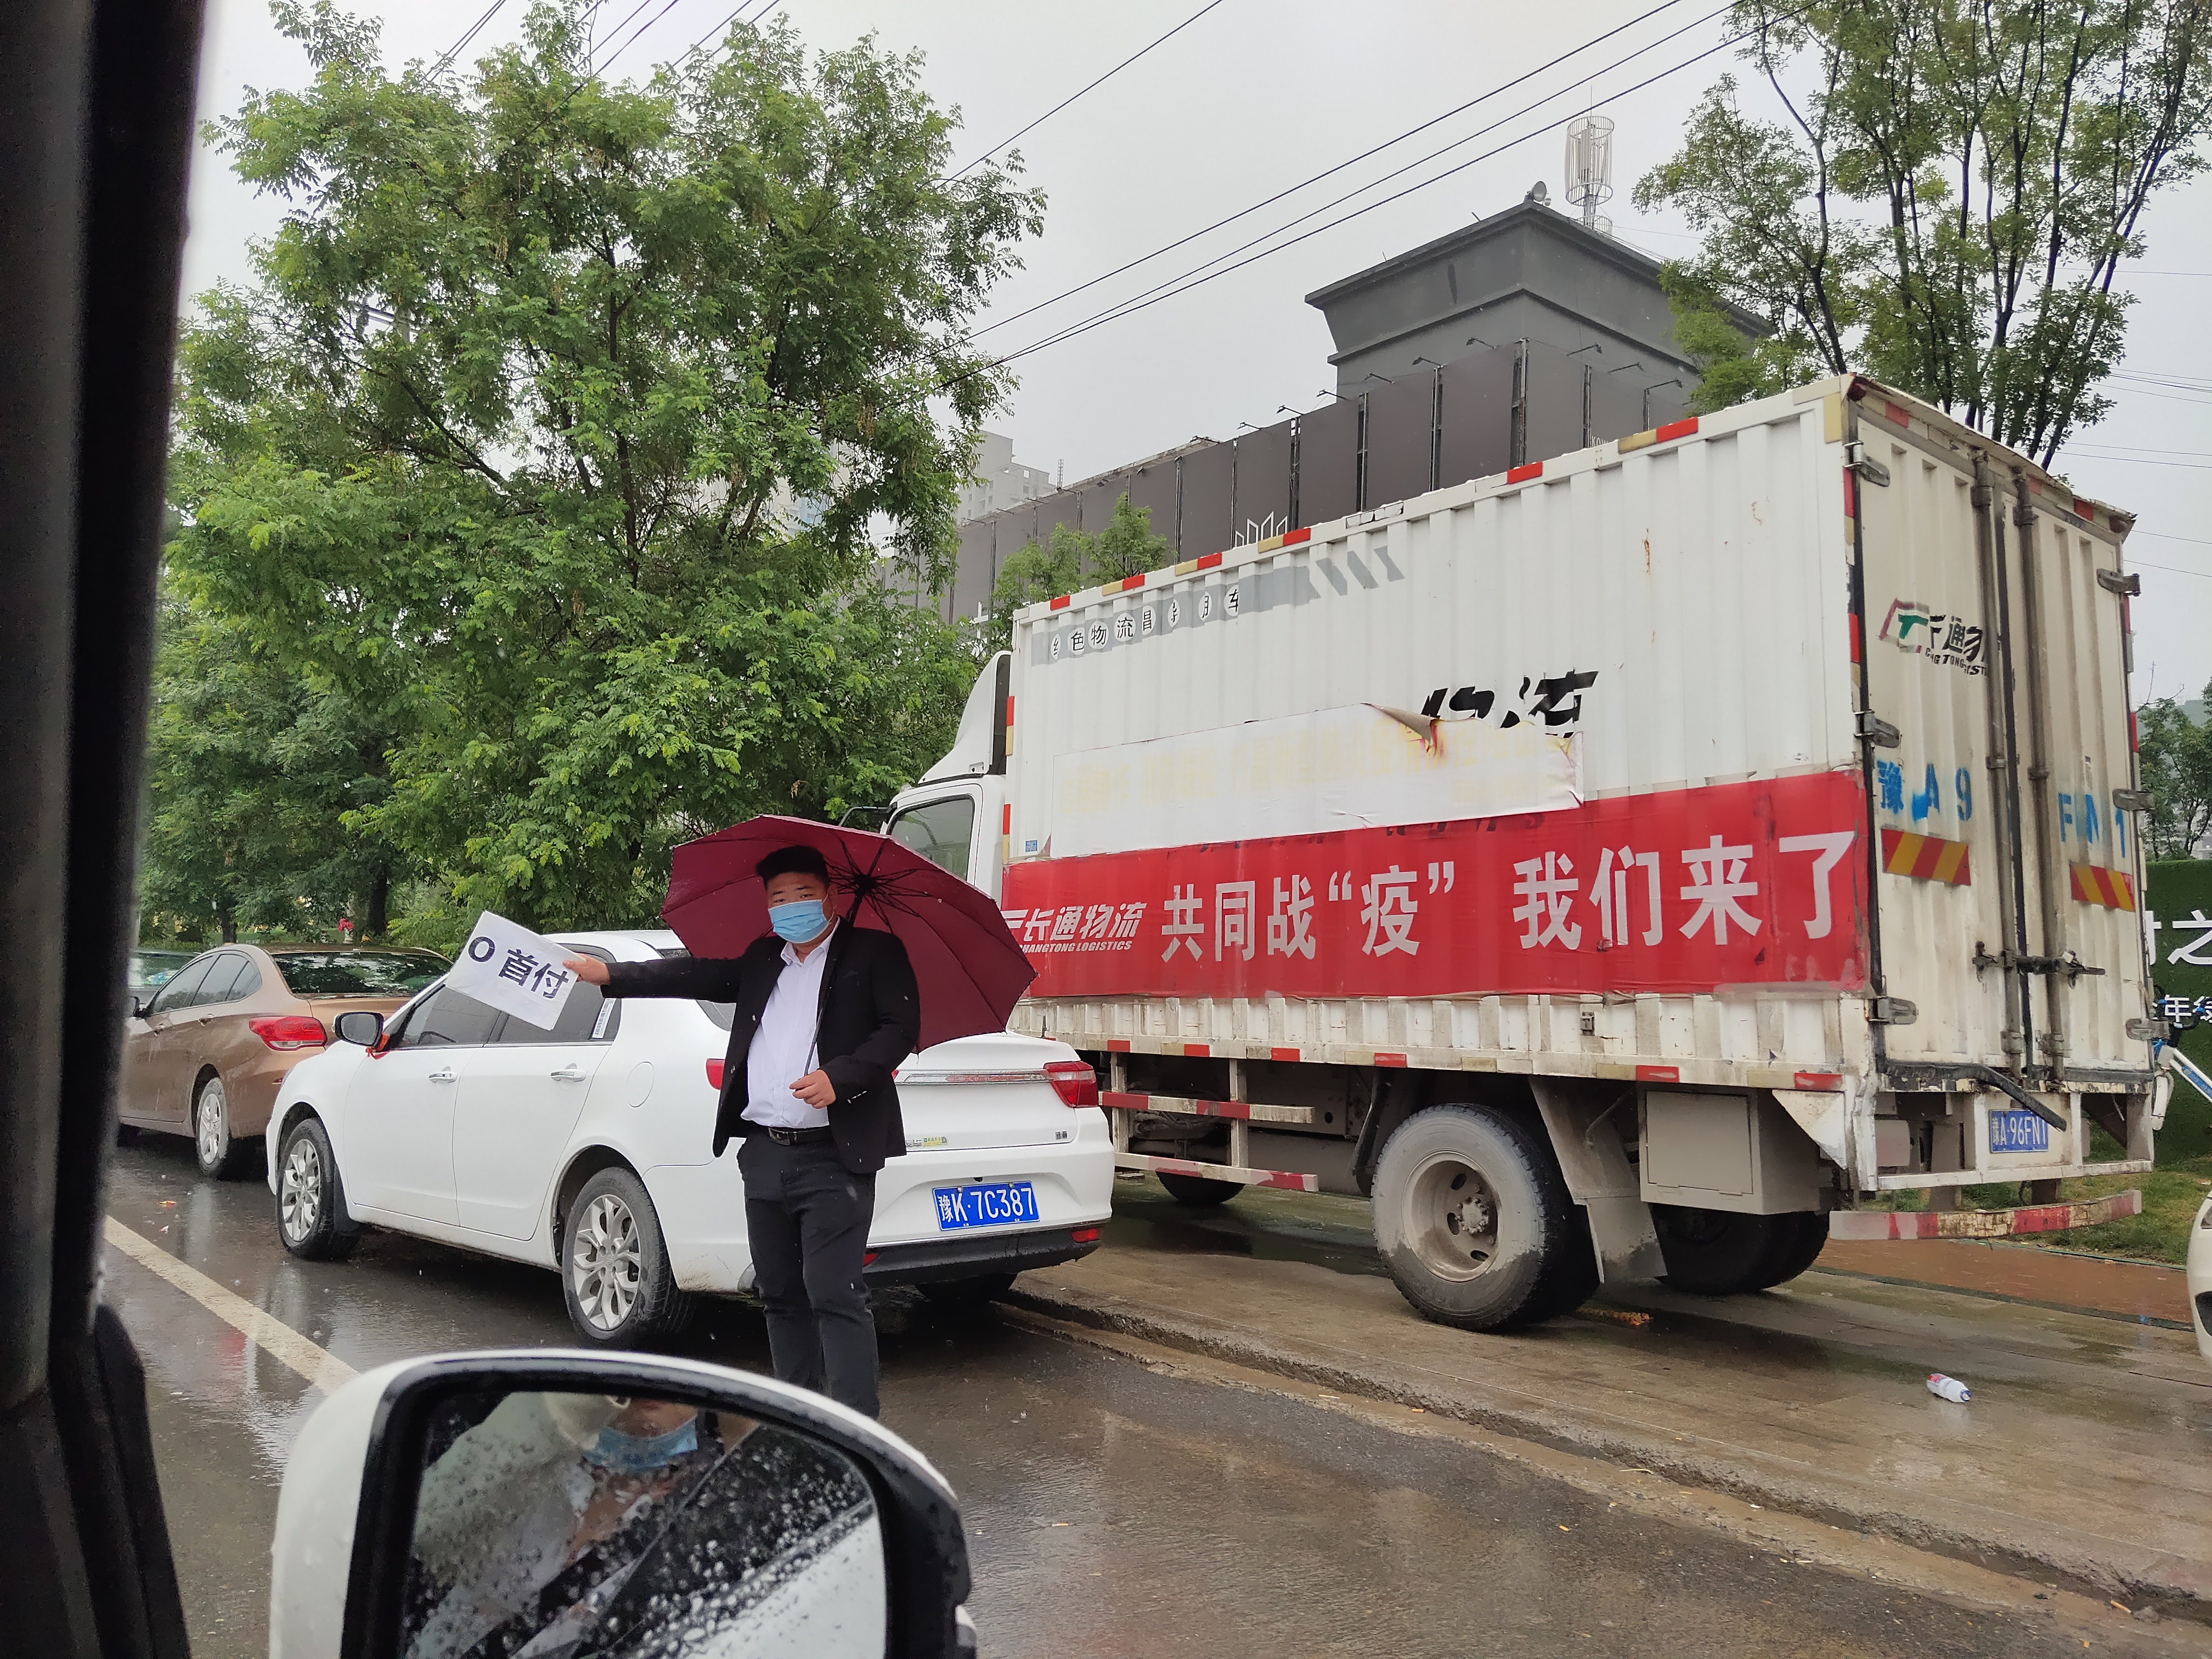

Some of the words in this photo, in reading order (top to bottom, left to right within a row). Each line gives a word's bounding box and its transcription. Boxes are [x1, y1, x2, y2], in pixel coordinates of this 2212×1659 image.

[1513, 831, 1855, 951] 我们来了
[1076, 940, 1132, 952] LOGISTICS
